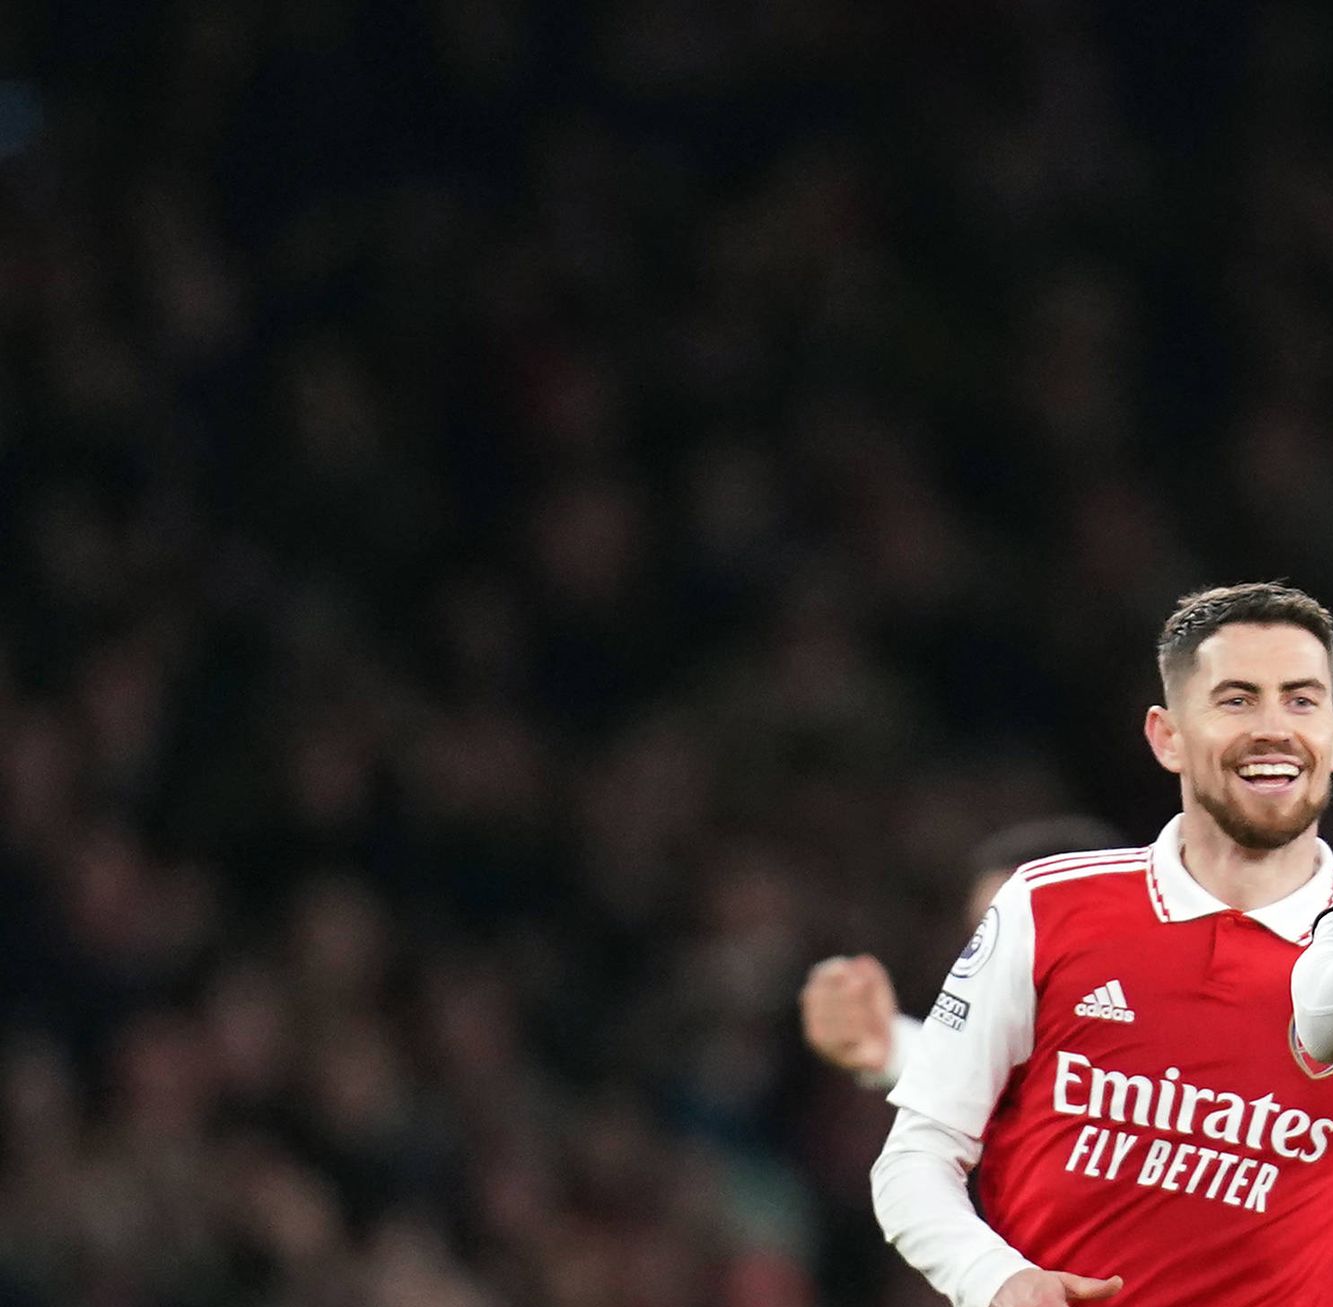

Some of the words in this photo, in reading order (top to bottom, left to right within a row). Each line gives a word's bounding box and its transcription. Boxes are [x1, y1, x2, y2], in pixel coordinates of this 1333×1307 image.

[1074, 1002, 1136, 1023] adidas
[1064, 1125, 1138, 1181] FLY
[1137, 1138, 1280, 1213] BETTER
